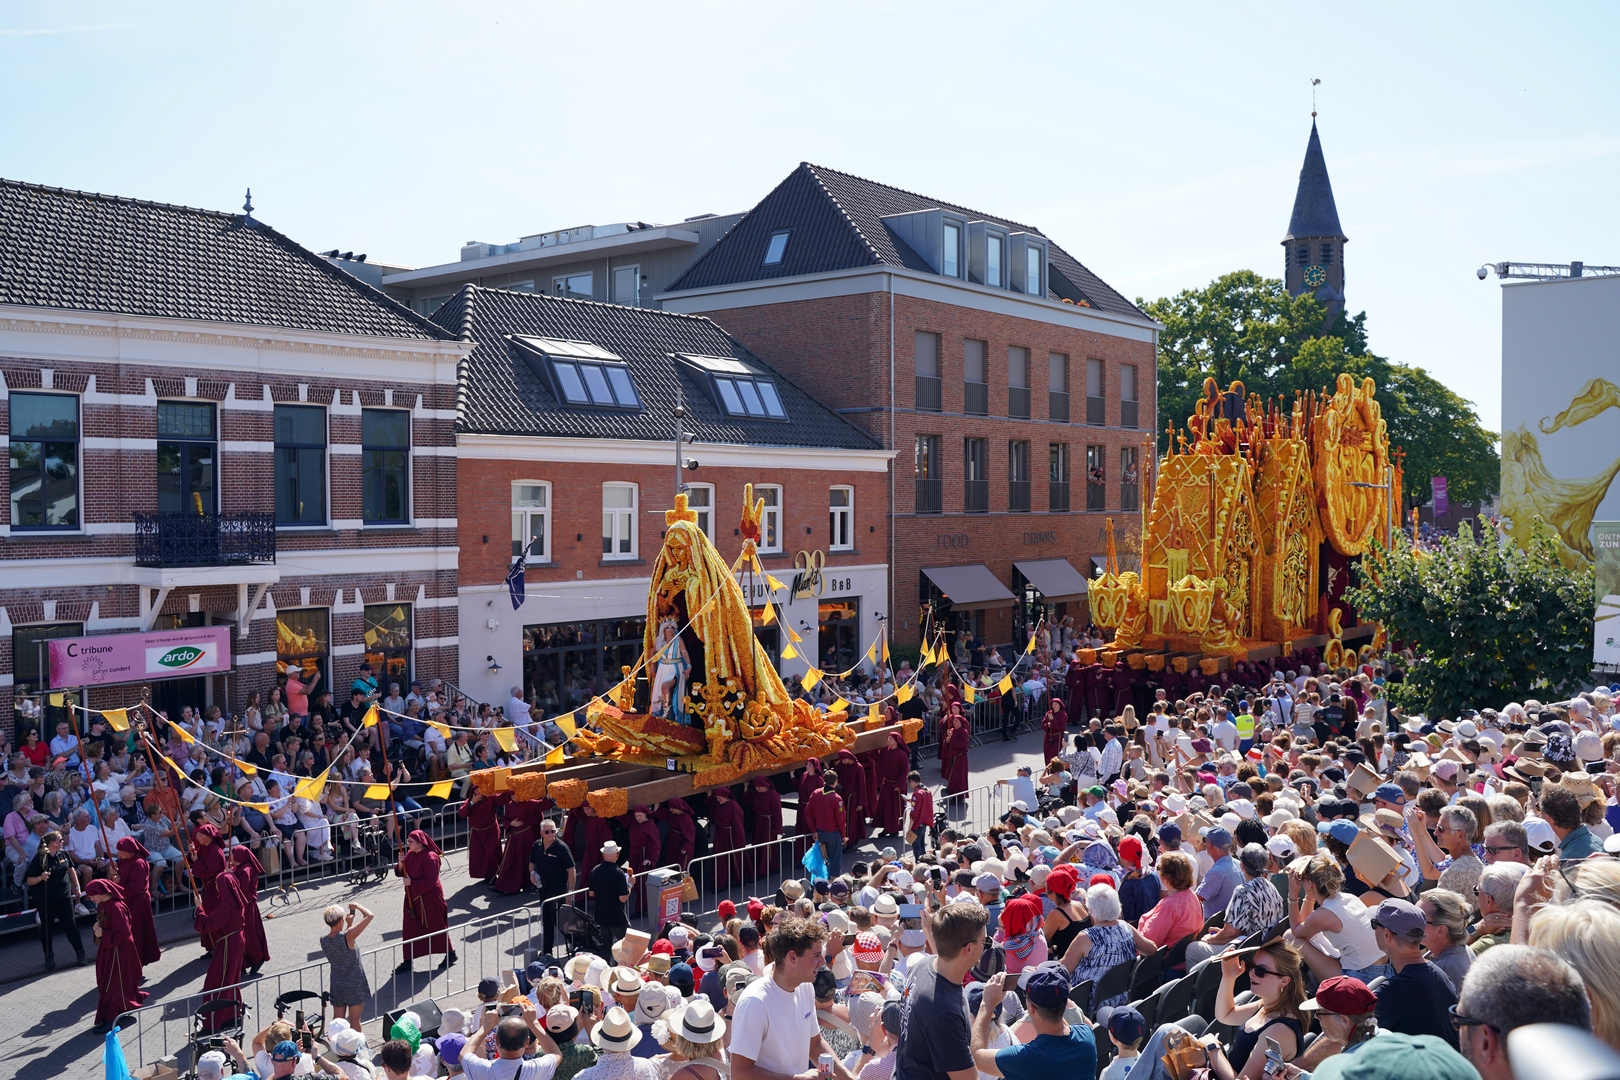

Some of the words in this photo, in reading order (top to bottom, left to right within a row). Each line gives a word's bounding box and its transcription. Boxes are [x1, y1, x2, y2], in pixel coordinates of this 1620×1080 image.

[938, 533, 970, 549] FOOD
[1023, 530, 1056, 544] DRINKS
[795, 549, 826, 599] 28
[789, 567, 820, 606] Markt
[67, 643, 78, 657] C
[81, 646, 113, 654] tribune
[163, 650, 195, 662] ardo
[92, 667, 108, 675] corso
[109, 665, 131, 673] zundert
